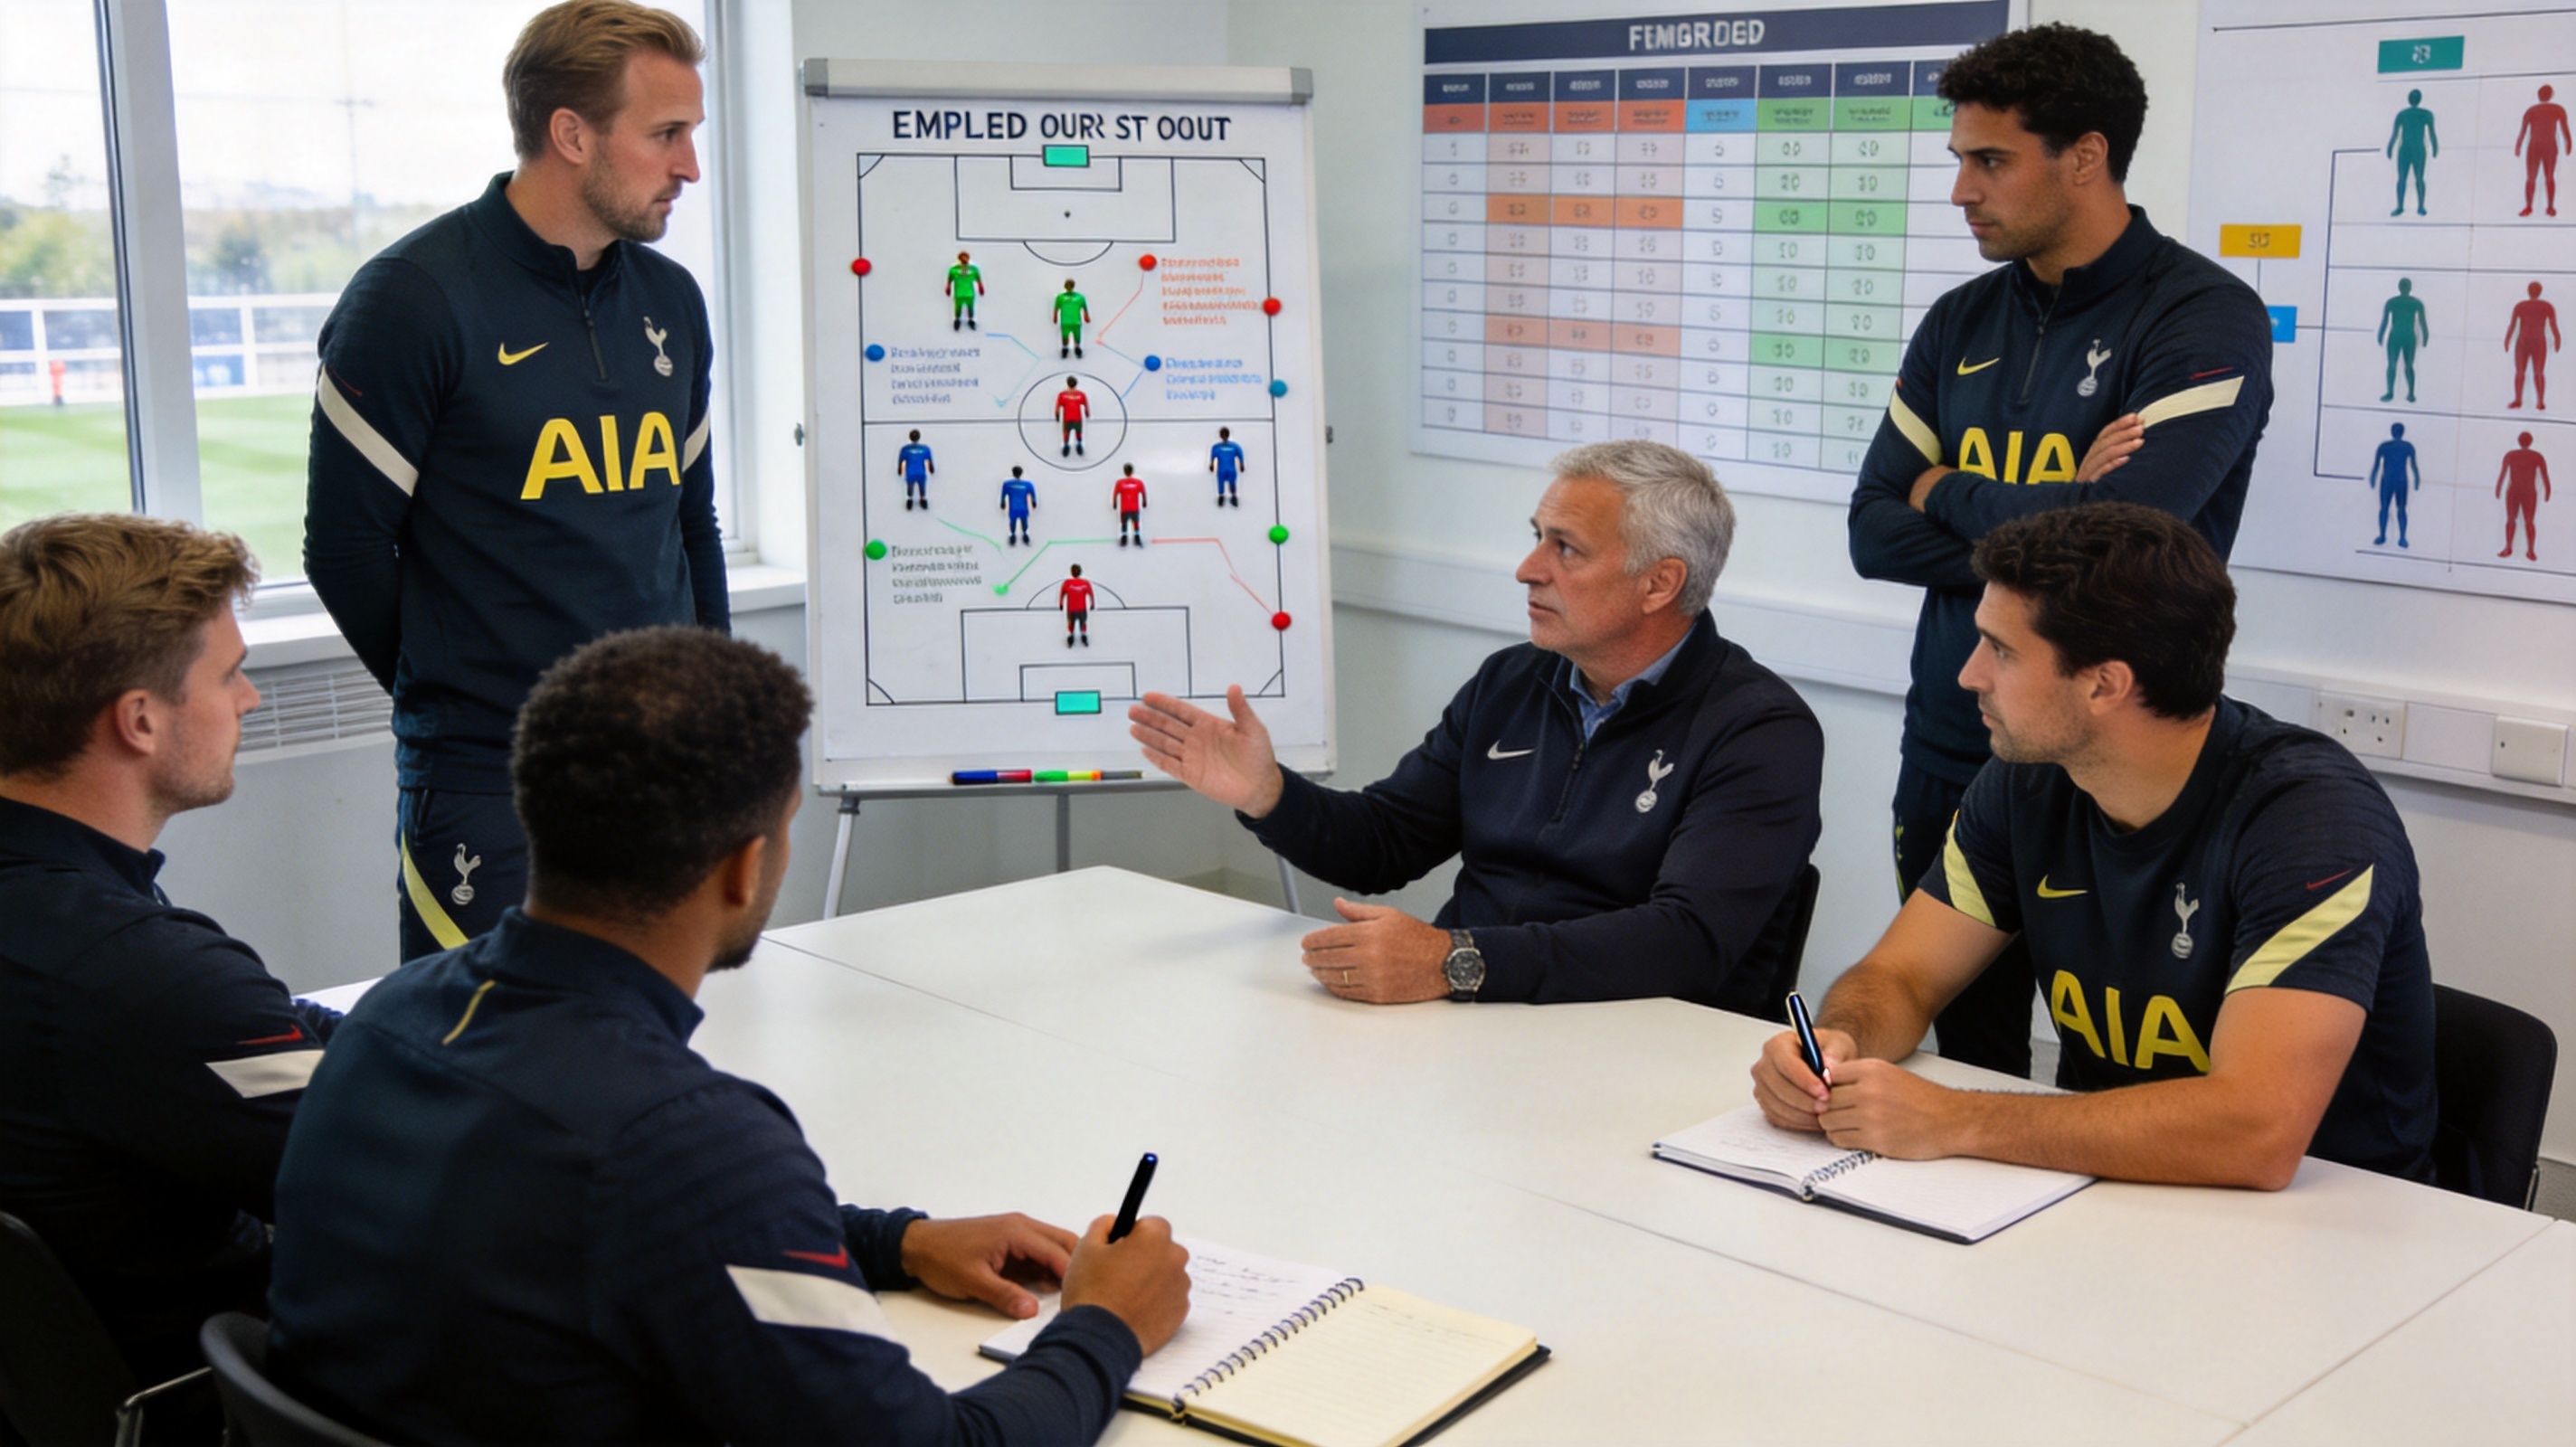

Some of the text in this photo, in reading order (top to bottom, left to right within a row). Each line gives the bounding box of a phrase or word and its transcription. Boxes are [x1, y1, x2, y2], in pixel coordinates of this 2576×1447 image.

[893, 110, 1028, 139] EMPLED
[1115, 114, 1149, 142] ST
[1157, 116, 1232, 141] OOUT
[520, 411, 681, 500] AIA
[2050, 969, 2211, 1073] AIA
